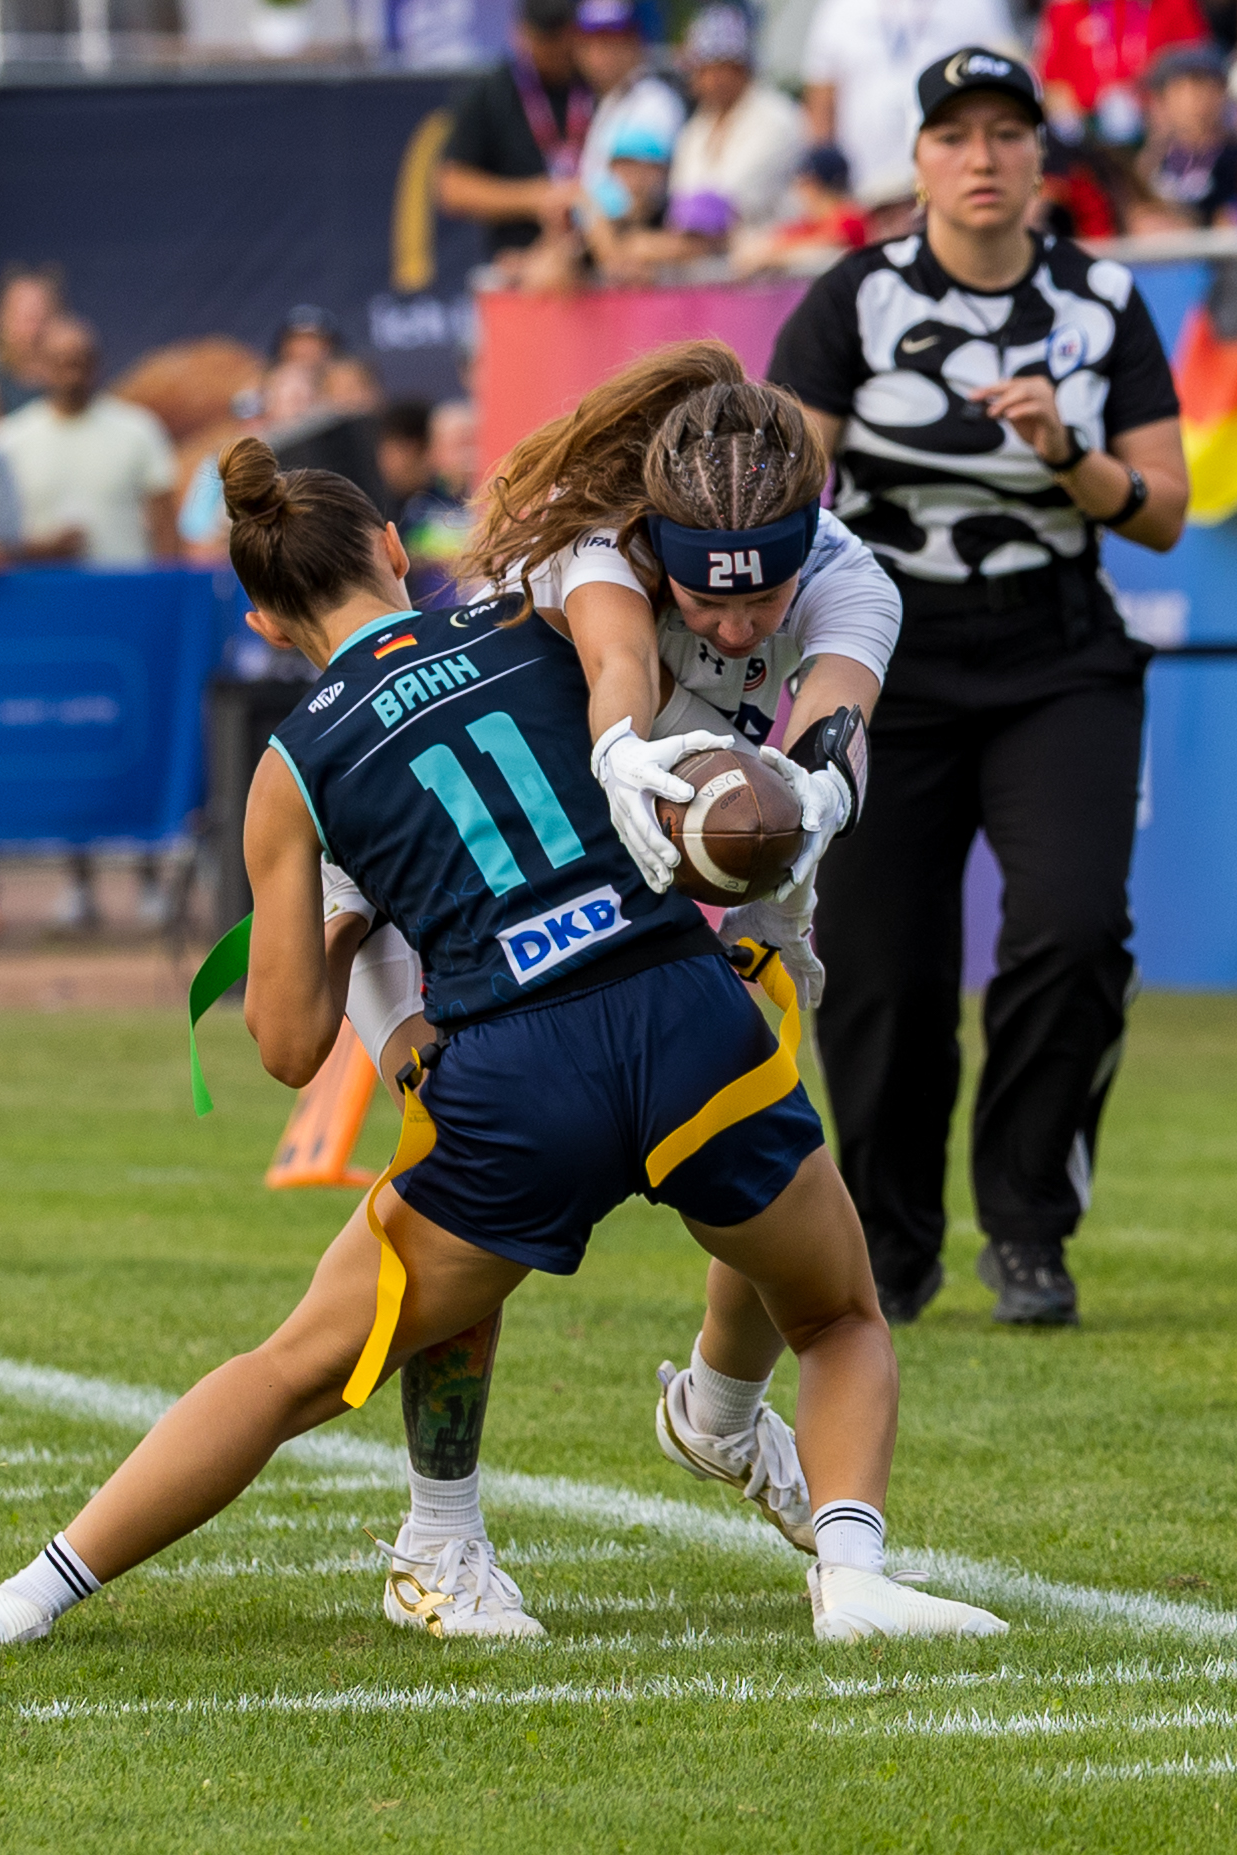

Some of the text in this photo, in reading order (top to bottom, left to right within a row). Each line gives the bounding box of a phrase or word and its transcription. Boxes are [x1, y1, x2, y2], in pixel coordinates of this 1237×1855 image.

[708, 550, 763, 587] 24
[371, 654, 481, 728] BAHN
[408, 711, 586, 898] 11
[702, 773, 741, 798] USA
[508, 900, 616, 972] DKB
